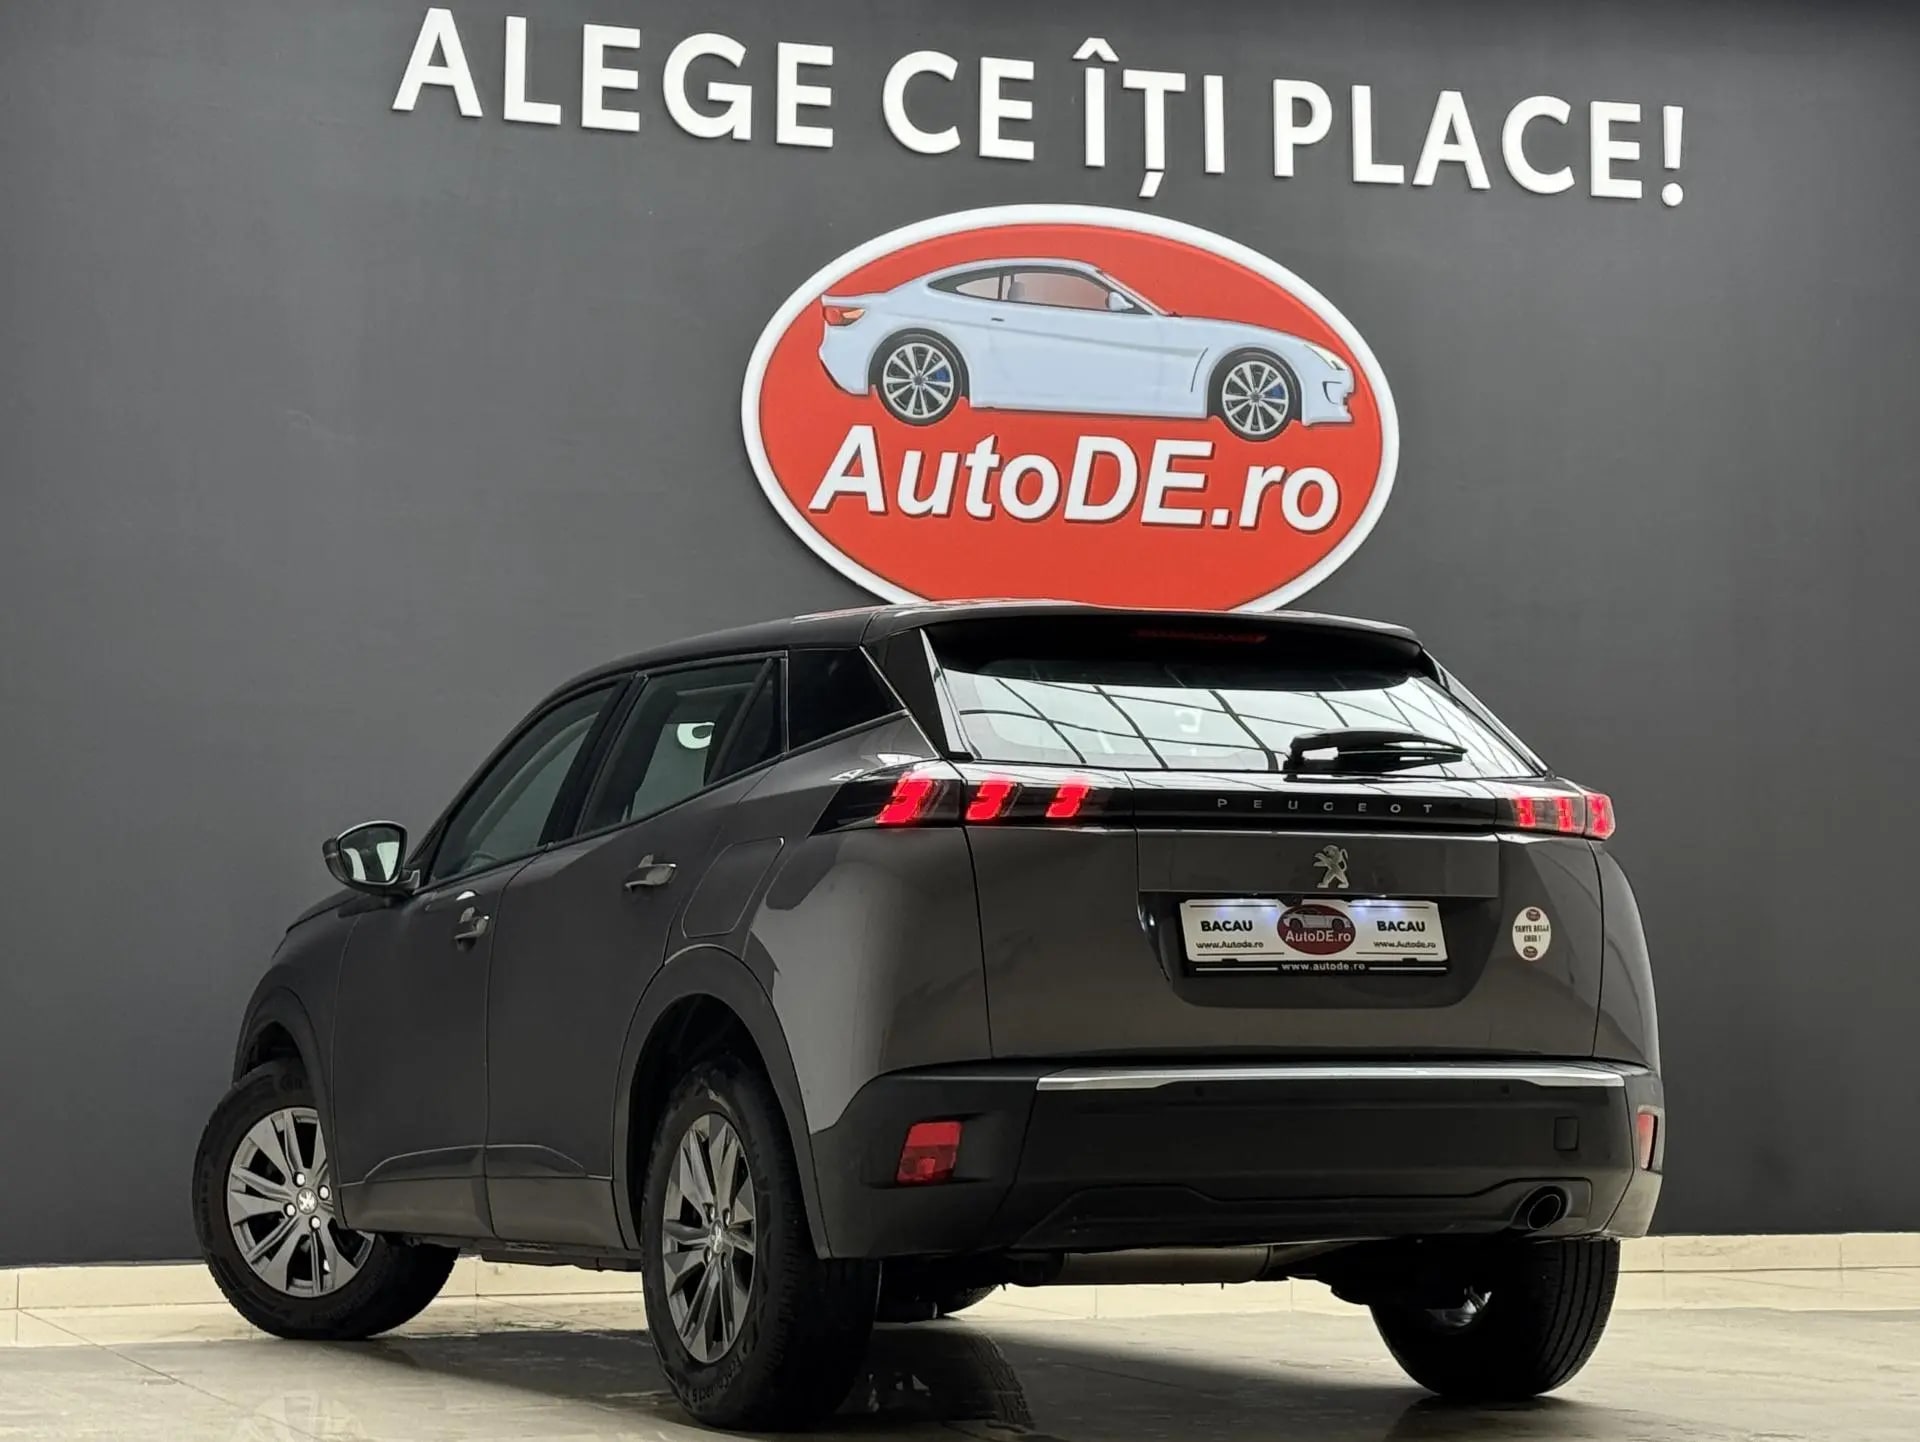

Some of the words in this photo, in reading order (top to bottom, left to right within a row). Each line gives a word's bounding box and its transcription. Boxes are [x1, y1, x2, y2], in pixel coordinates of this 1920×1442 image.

[392, 7, 834, 148] ALEGE
[882, 50, 1035, 160] CE
[1072, 37, 1225, 198] ÎȚI
[1272, 78, 1684, 207] PLACE!
[808, 424, 1340, 532] AutoDE.ro
[1216, 798, 1432, 814] PEUGEOT
[1200, 920, 1253, 932] BACAU
[1376, 920, 1426, 932] BACAU
[1285, 930, 1352, 942] AutoDE.ro
[1281, 962, 1366, 971] www.autode.ro
